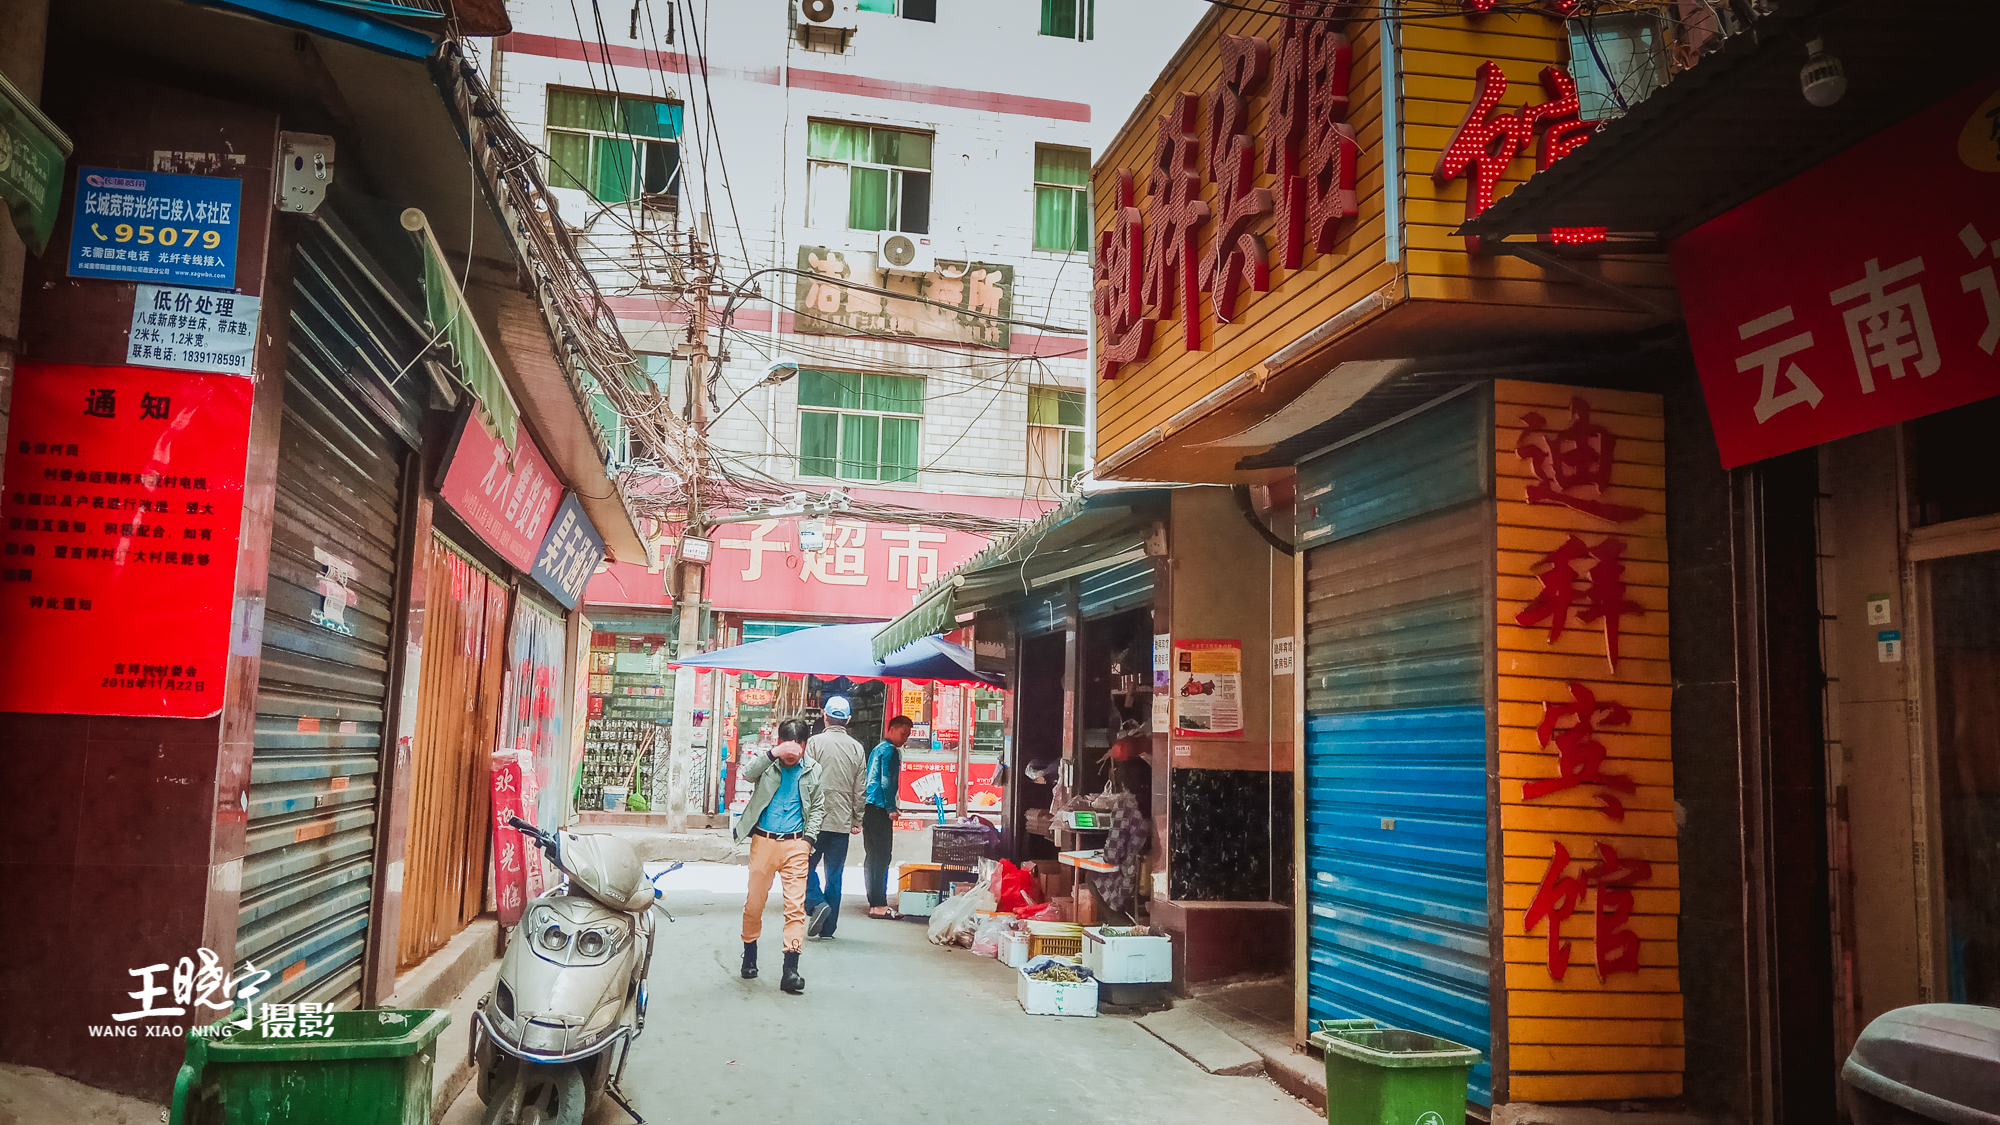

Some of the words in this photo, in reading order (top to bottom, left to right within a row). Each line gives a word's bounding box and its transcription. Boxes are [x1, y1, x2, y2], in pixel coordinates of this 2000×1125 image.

[1432, 0, 1608, 248] 馆
[85, 191, 232, 224] 长城宽带光纤已接入本社区
[114, 223, 221, 249] 95079
[81, 246, 150, 262] 无需固定电话
[158, 252, 226, 268] 光纤专线接入
[153, 289, 235, 318] 低价处理
[84, 388, 172, 421] 通知
[101, 677, 205, 692] 2018年11月22日
[1514, 395, 1653, 984] 迪拜宾馆
